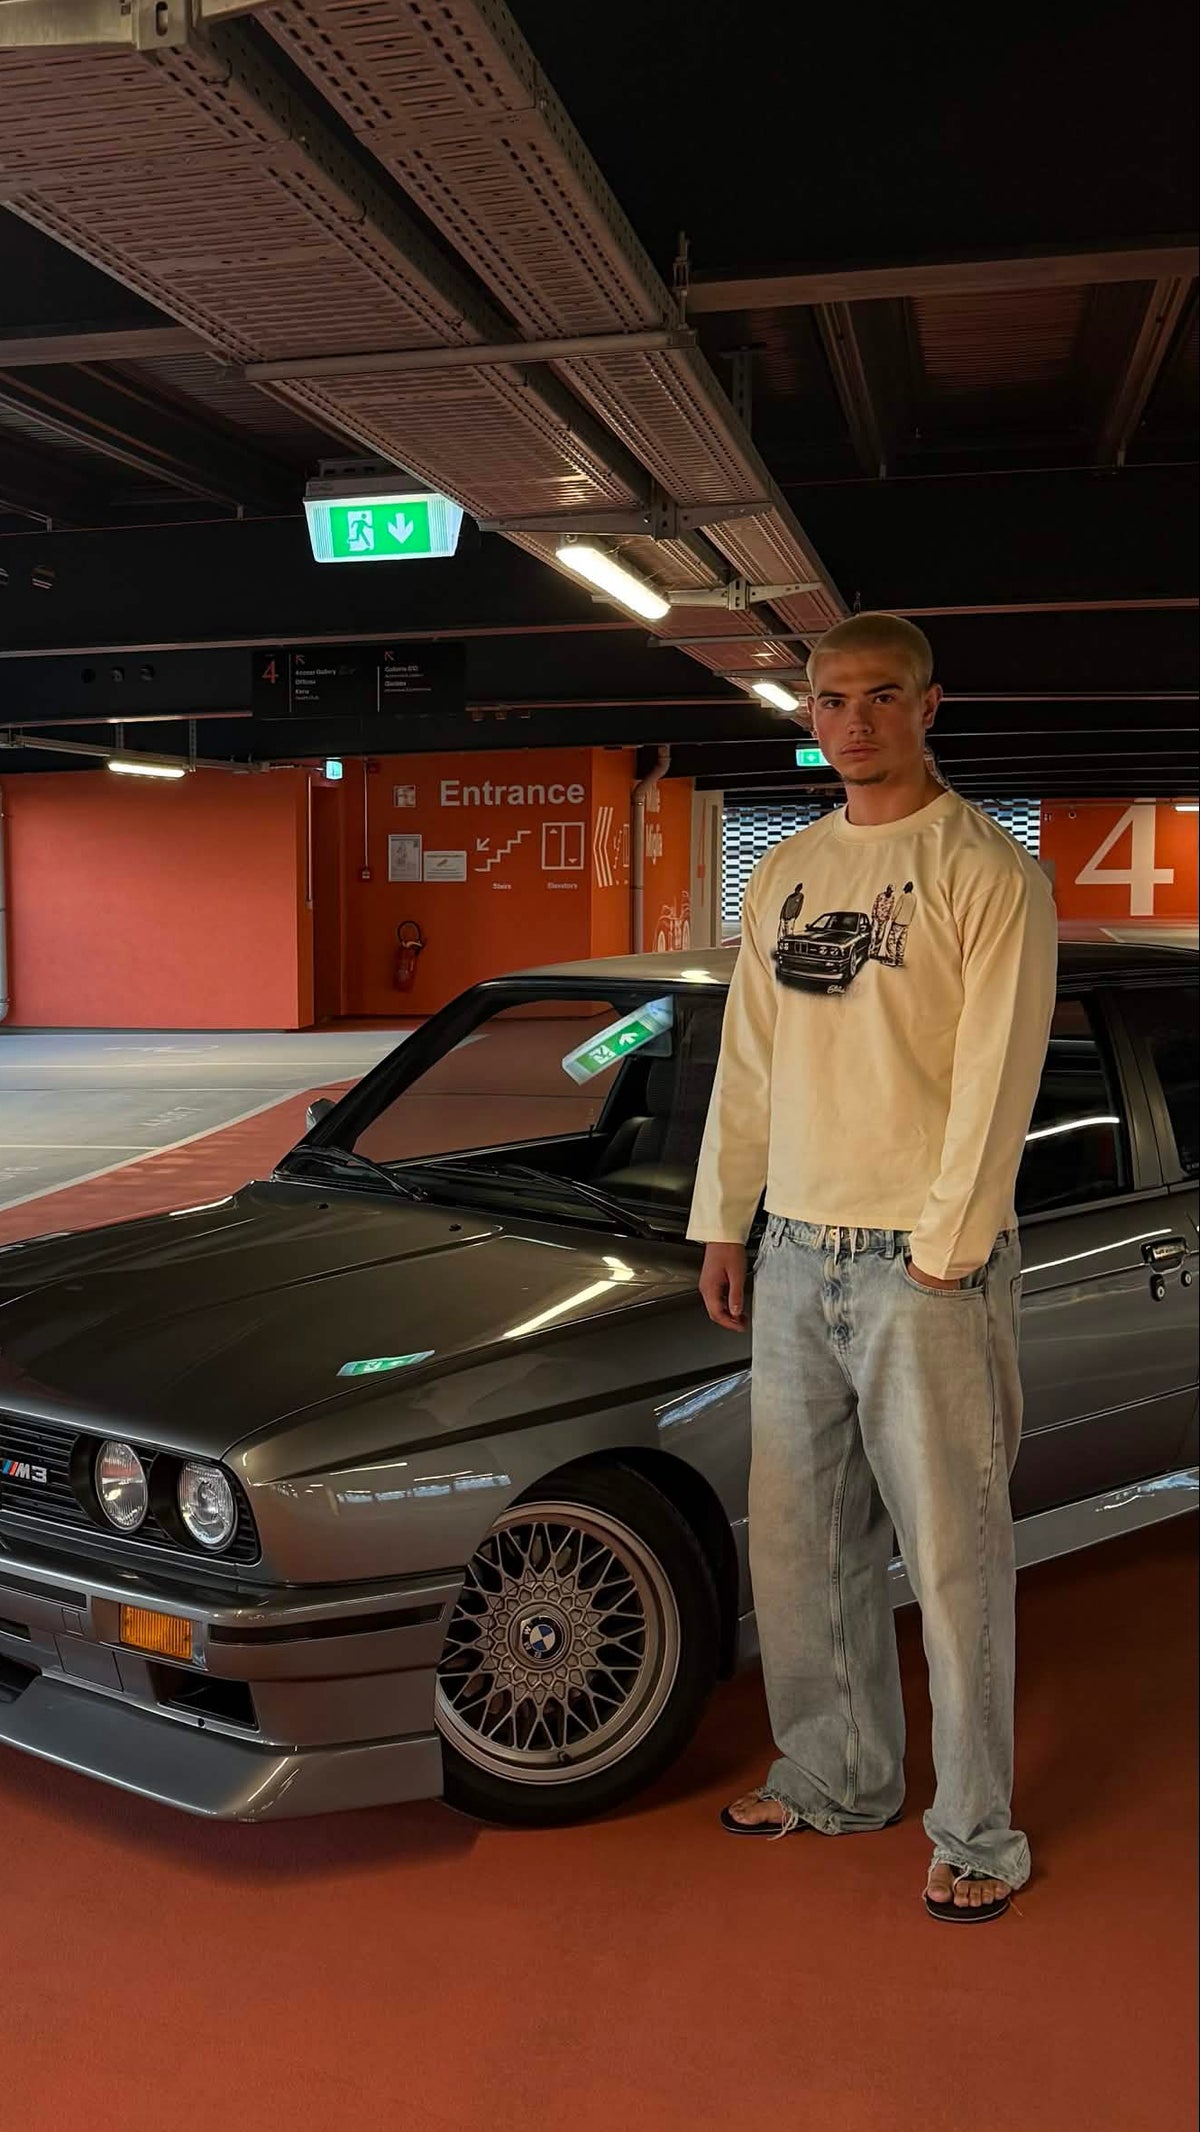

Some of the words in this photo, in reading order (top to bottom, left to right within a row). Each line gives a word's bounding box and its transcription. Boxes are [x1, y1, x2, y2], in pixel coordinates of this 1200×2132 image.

[261, 660, 279, 684] 4
[440, 779, 586, 807] Entrance
[1075, 798, 1174, 916] 4
[492, 882, 512, 890] Stairs
[547, 882, 578, 890] Elevators
[15, 1462, 47, 1483] M3
